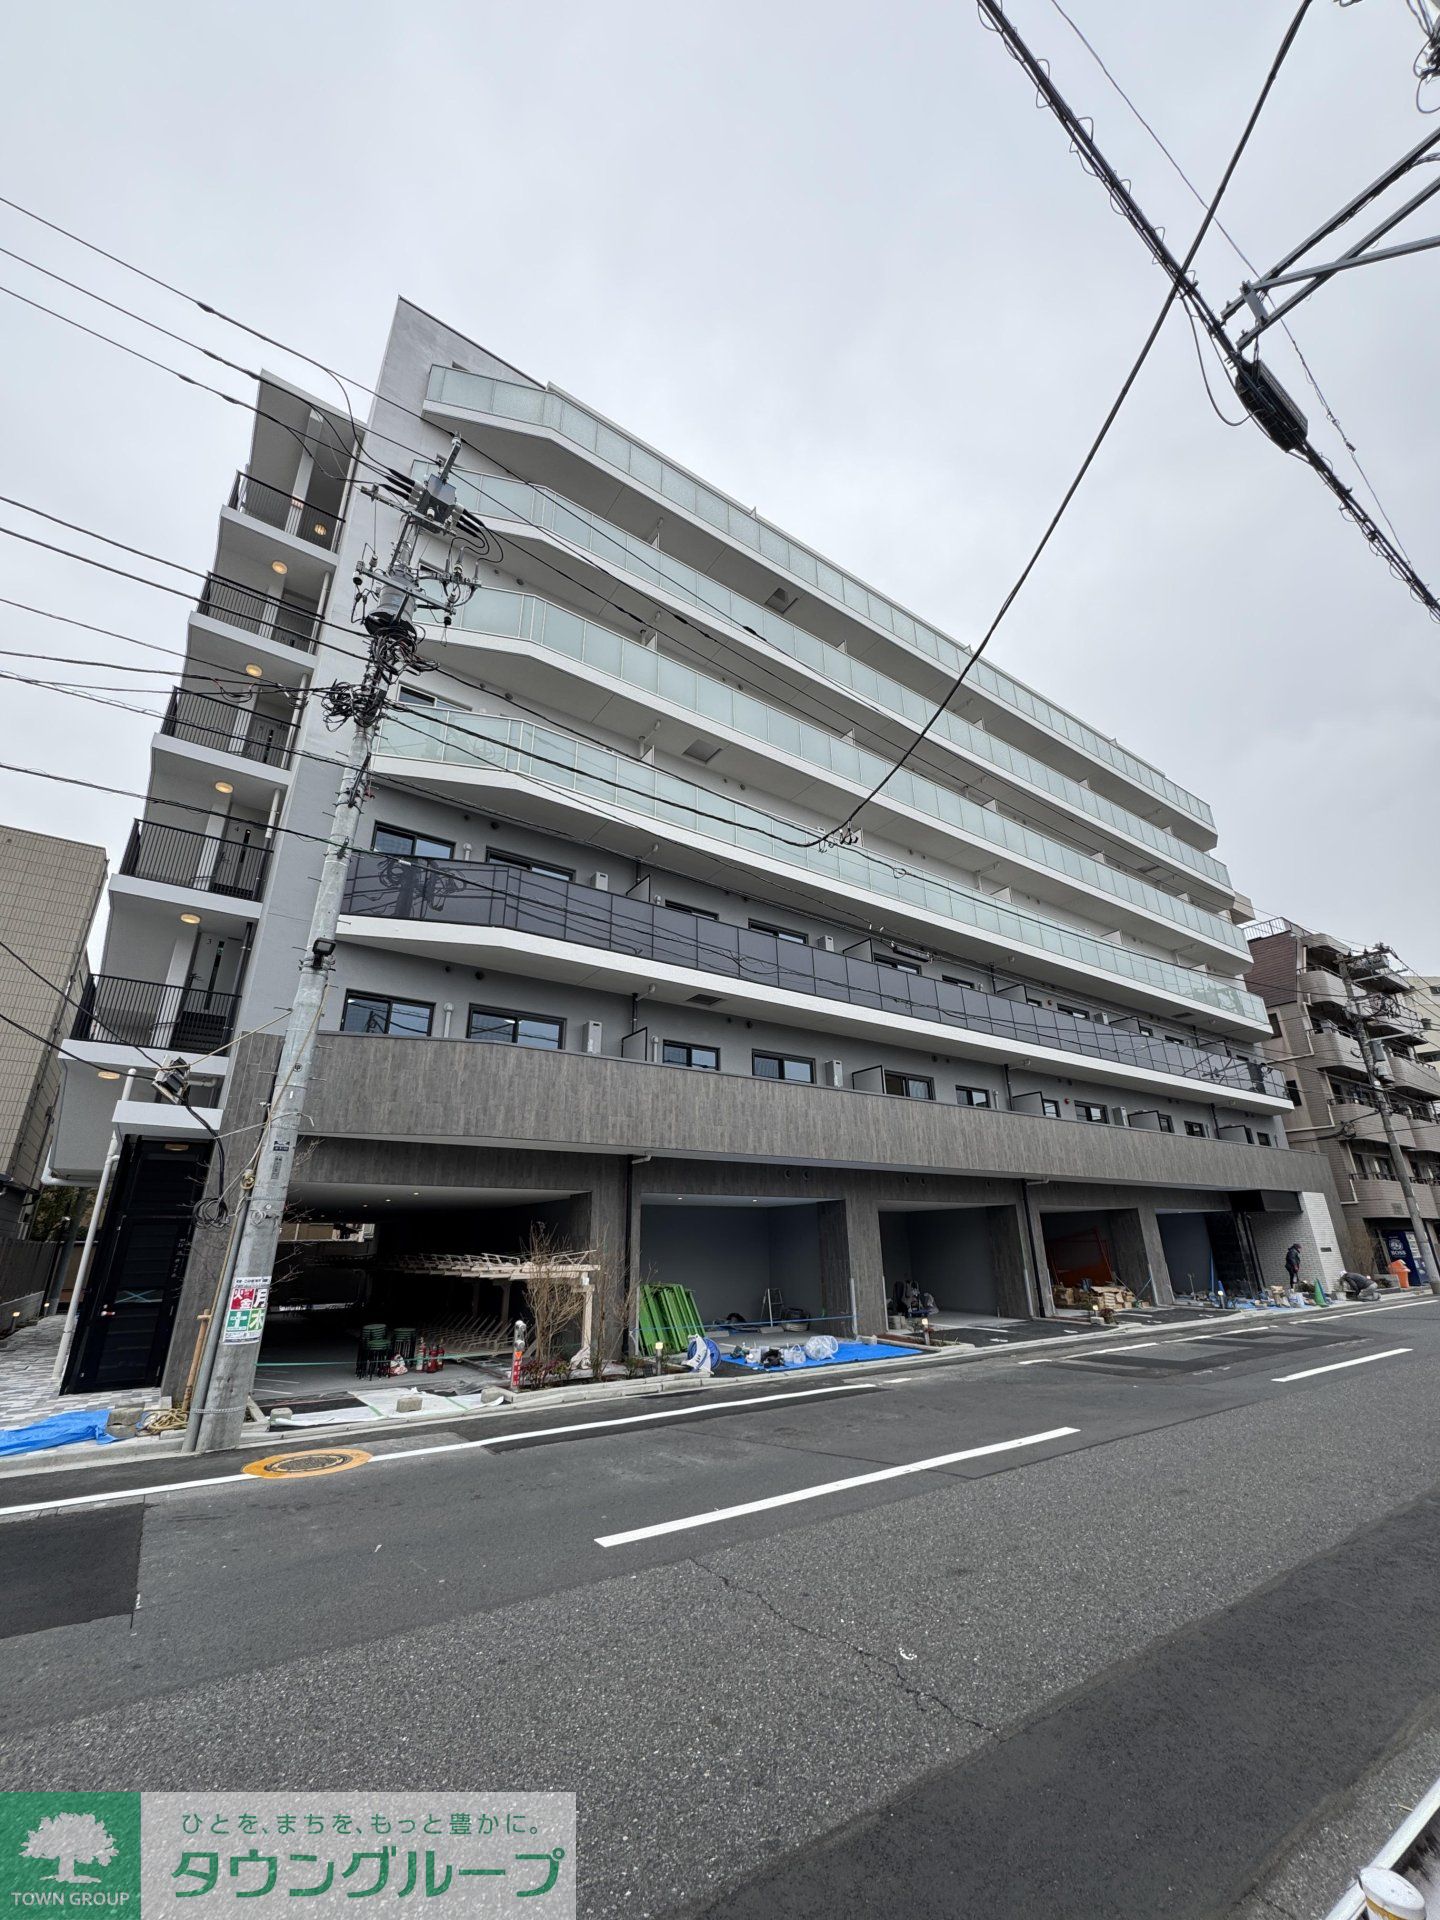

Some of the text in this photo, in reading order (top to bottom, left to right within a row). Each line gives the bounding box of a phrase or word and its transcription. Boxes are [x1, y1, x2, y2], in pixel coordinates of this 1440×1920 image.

[253, 1288, 267, 1308] 月
[228, 1311, 248, 1329] 土
[248, 1309, 265, 1330] 木
